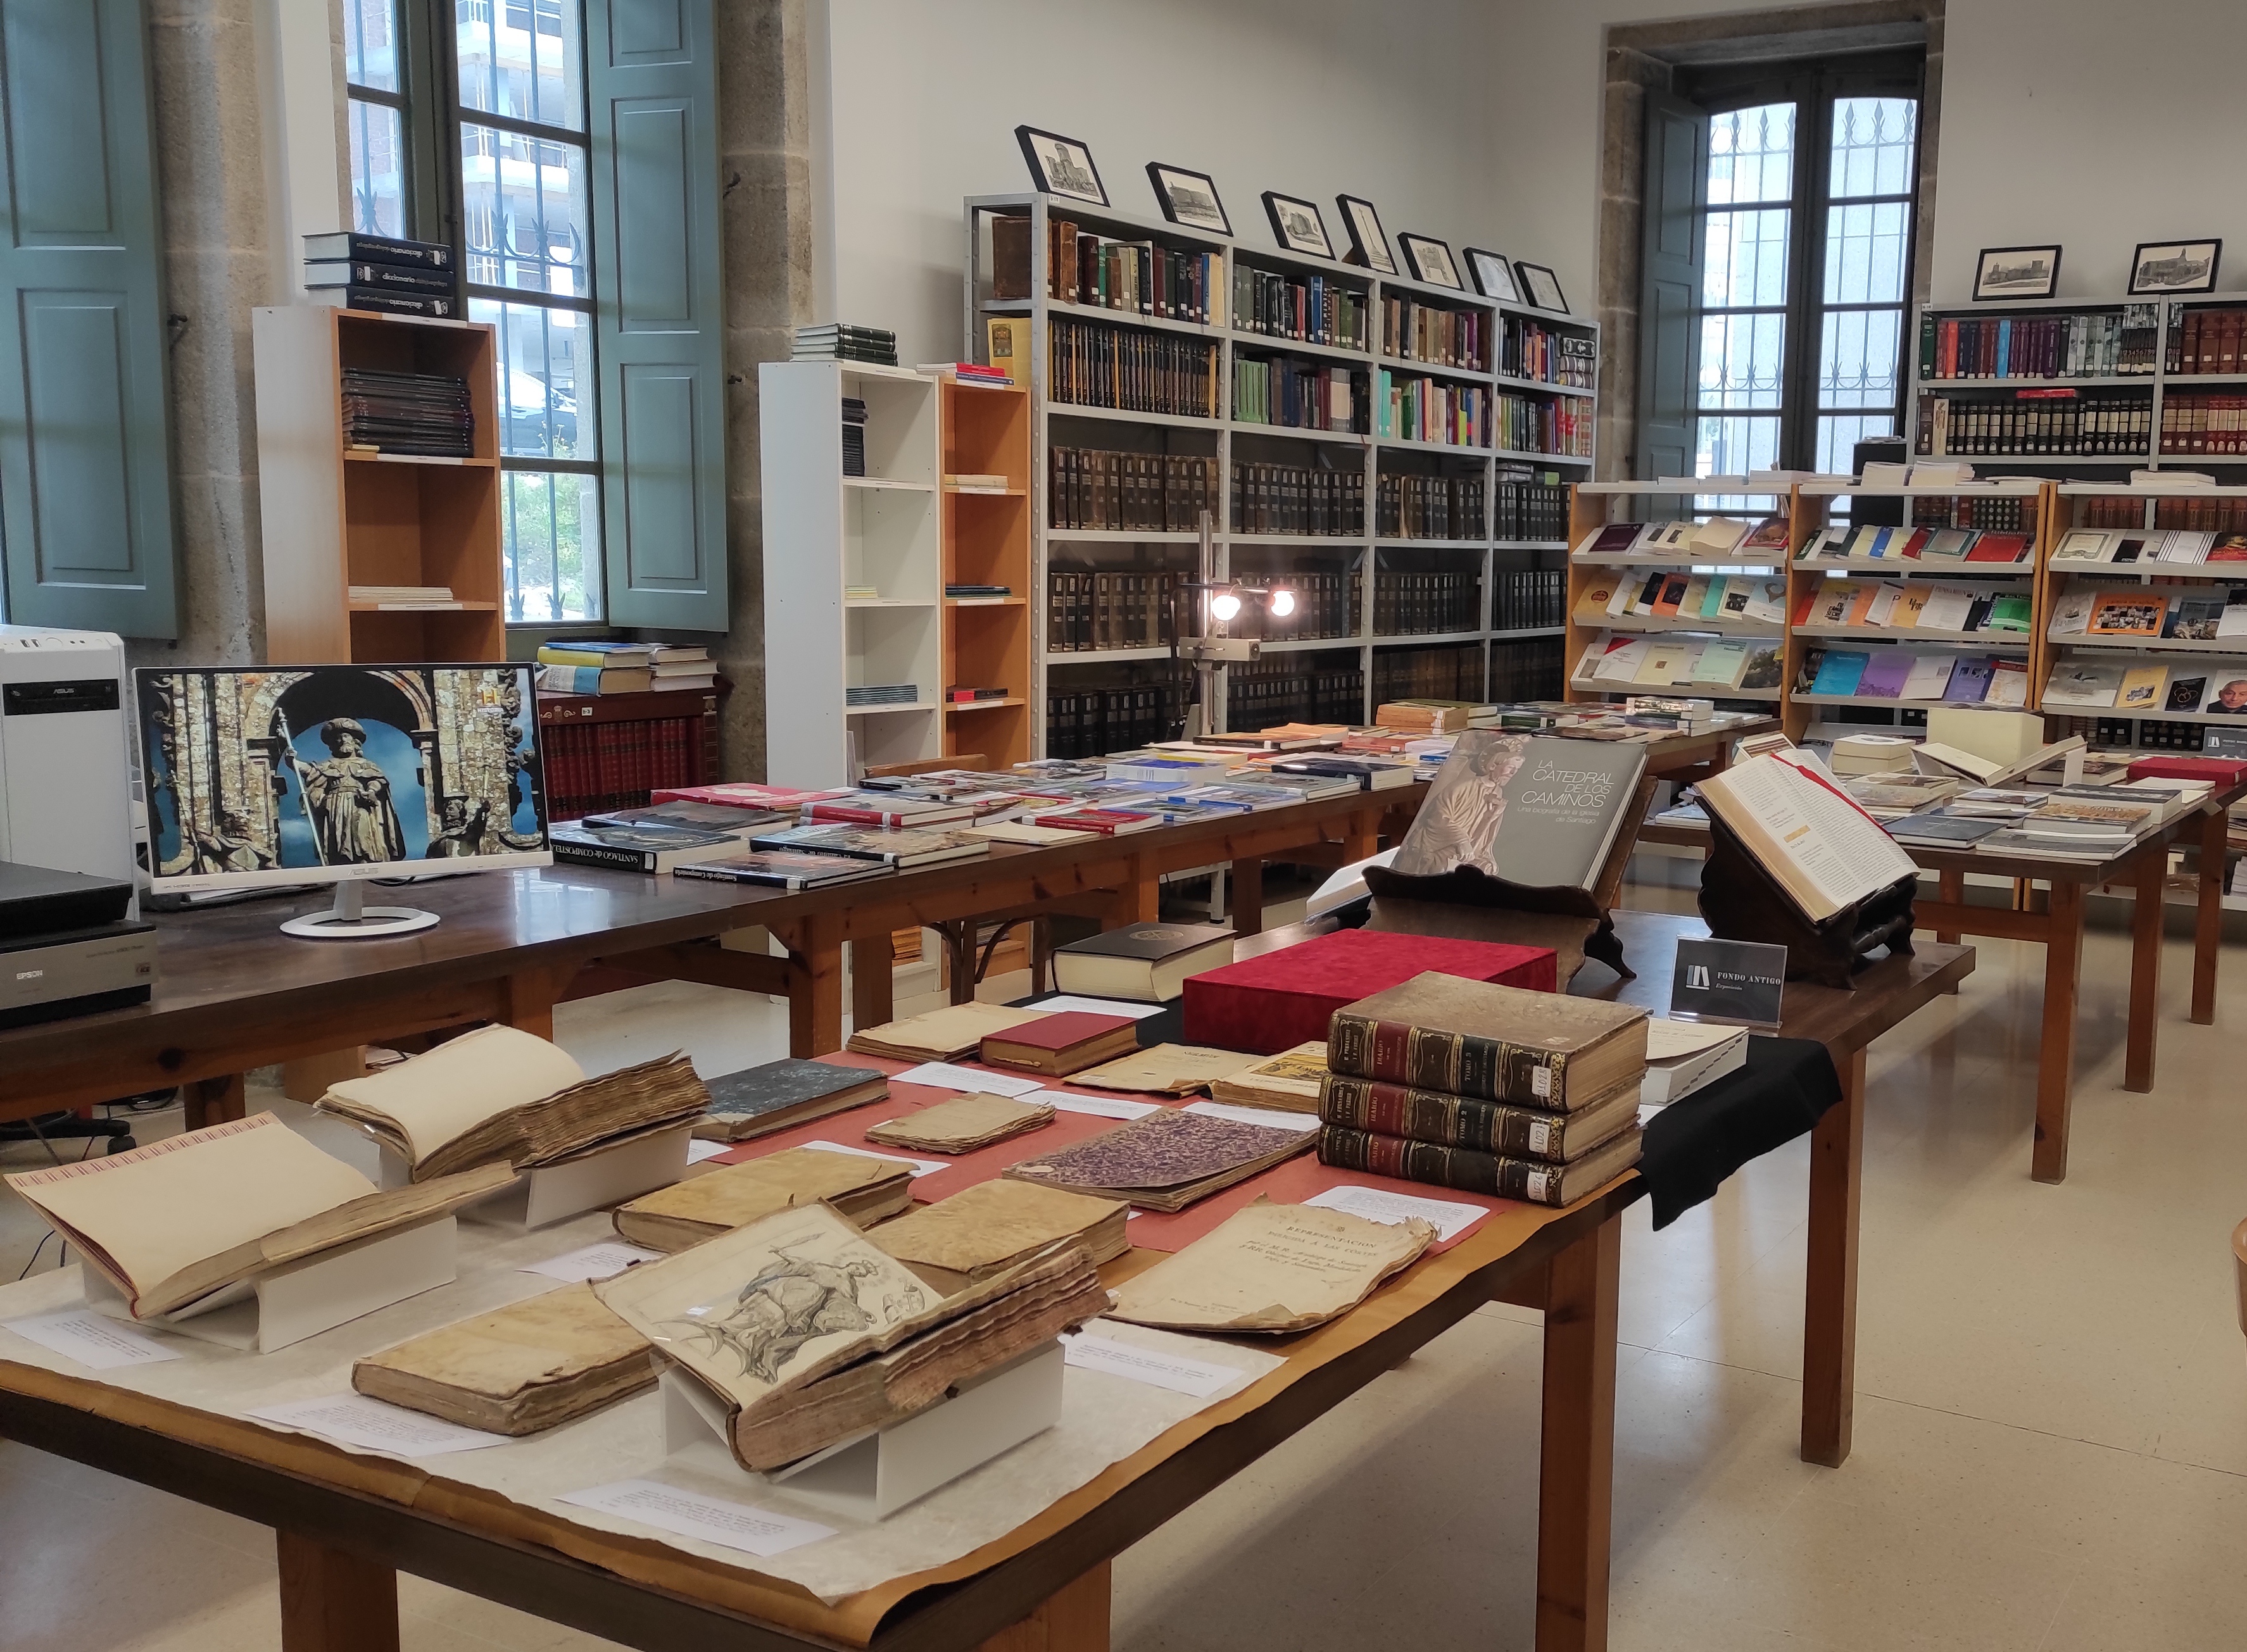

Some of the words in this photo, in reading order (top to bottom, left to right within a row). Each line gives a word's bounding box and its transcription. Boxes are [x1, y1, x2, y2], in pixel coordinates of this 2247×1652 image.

[1538, 760, 1553, 769] LA
[1532, 768, 1614, 785] CATEDRAL
[1564, 784, 1583, 793] DE
[1584, 784, 1612, 794] LOS
[1521, 791, 1606, 808] CAMINOS
[1566, 816, 1597, 824] Santiago
[594, 850, 602, 859] de
[603, 851, 638, 864] SANTIAGO
[348, 867, 379, 876] ASUS
[674, 869, 706, 879] Compostela
[713, 872, 737, 882] Santiago
[16, 970, 43, 980] EPSON
[1717, 972, 1746, 981] FONDO
[1748, 975, 1781, 986] ANTIGO
[1287, 1225, 1377, 1248] REPRESENTACION
[1268, 1231, 1306, 1243] DIRIGIDA
[1344, 1248, 1378, 1257] CORTES
